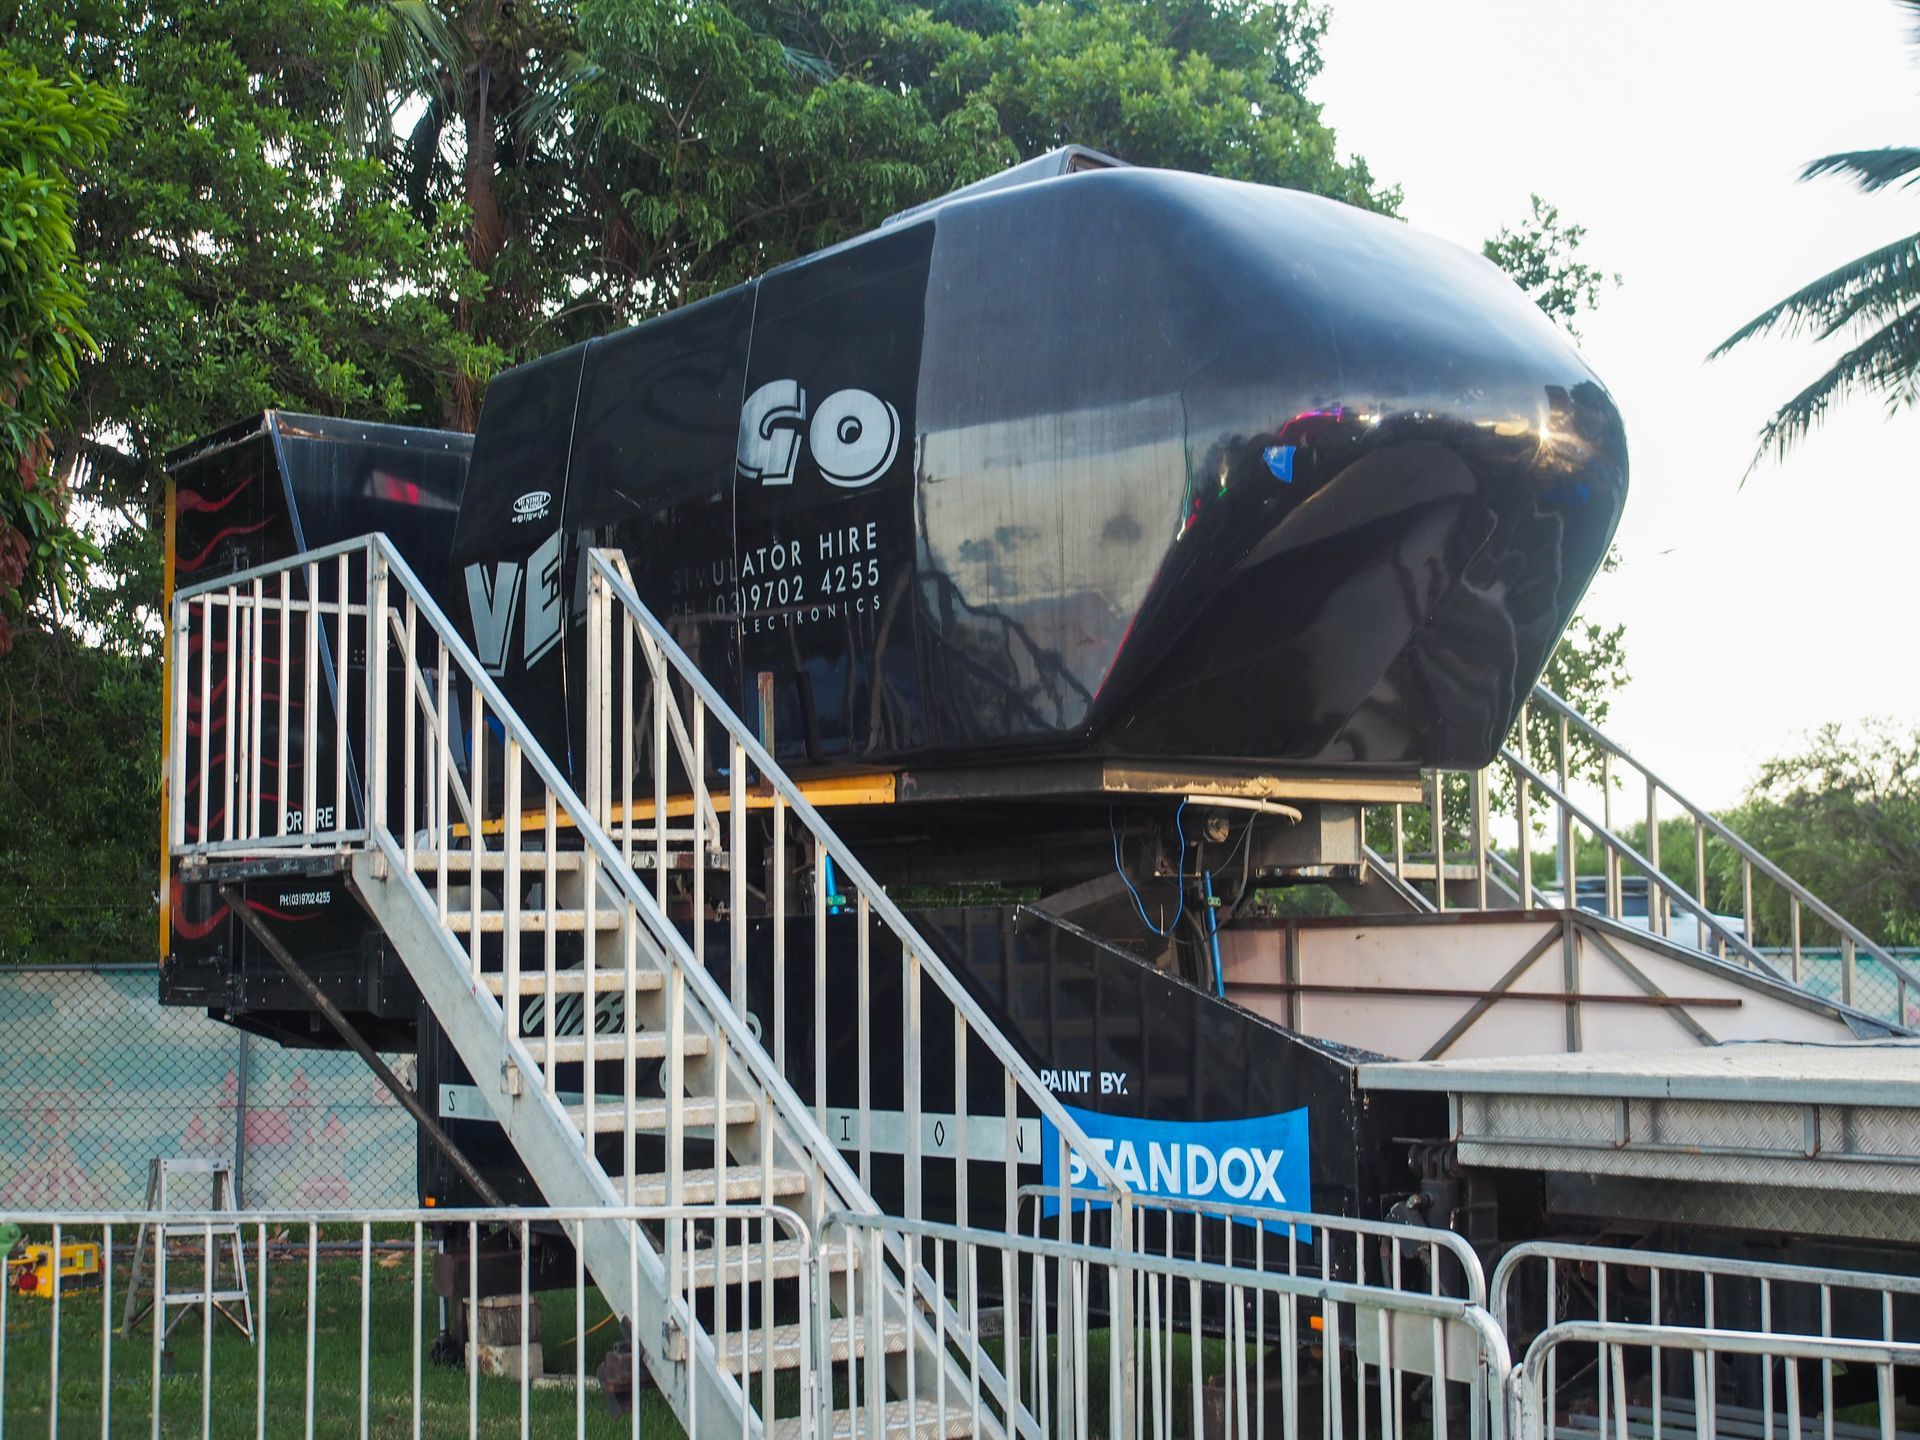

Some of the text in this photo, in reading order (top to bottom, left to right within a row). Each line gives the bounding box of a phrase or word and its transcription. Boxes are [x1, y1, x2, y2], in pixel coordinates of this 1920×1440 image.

[737, 378, 901, 488] GO
[818, 522, 878, 561] HIRE
[820, 558, 880, 595] 4255
[730, 595, 881, 639] ELECTRONICS
[1040, 1069, 1092, 1093] PAINT
